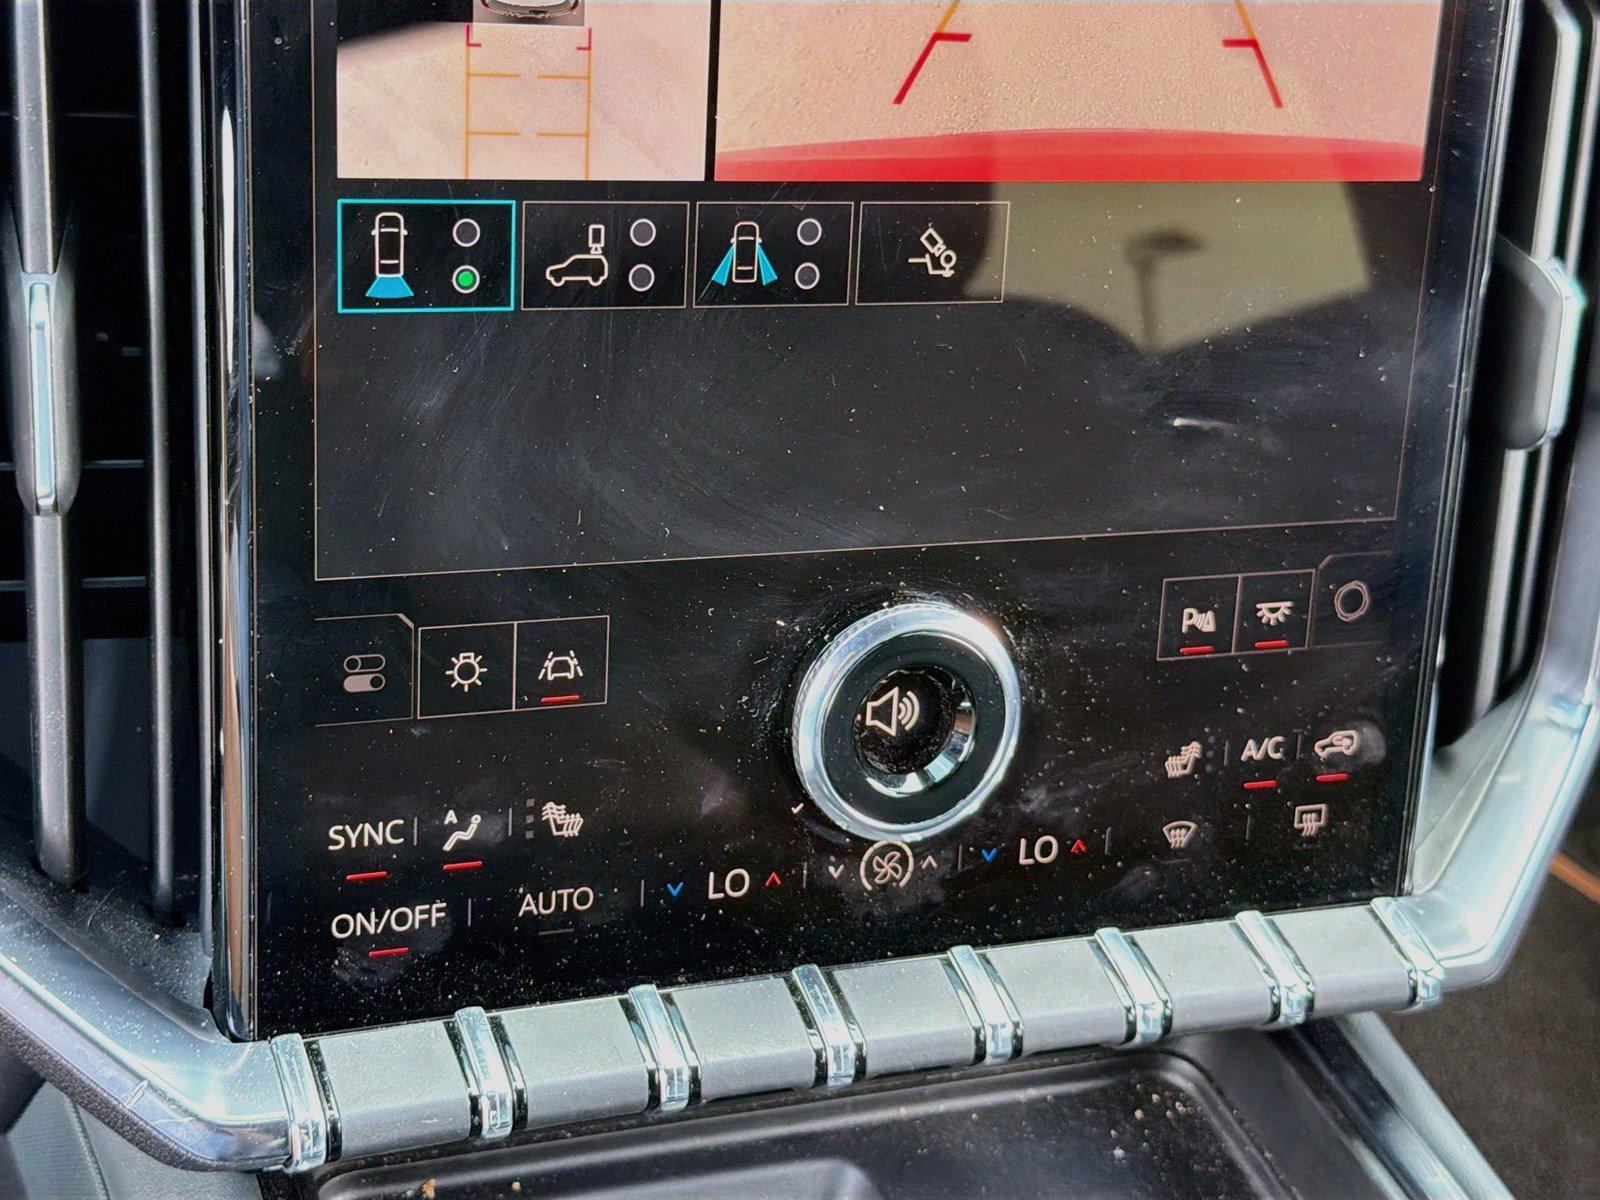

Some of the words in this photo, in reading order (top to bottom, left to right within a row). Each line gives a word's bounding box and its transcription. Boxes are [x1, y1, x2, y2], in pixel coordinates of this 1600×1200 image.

[1241, 736, 1286, 762] A/C
[445, 809, 458, 825] A
[328, 819, 405, 851] SYNC
[1019, 835, 1059, 866] LO
[707, 868, 750, 900] LO
[518, 887, 595, 917] AUTO
[331, 902, 447, 939] ON/OFF
